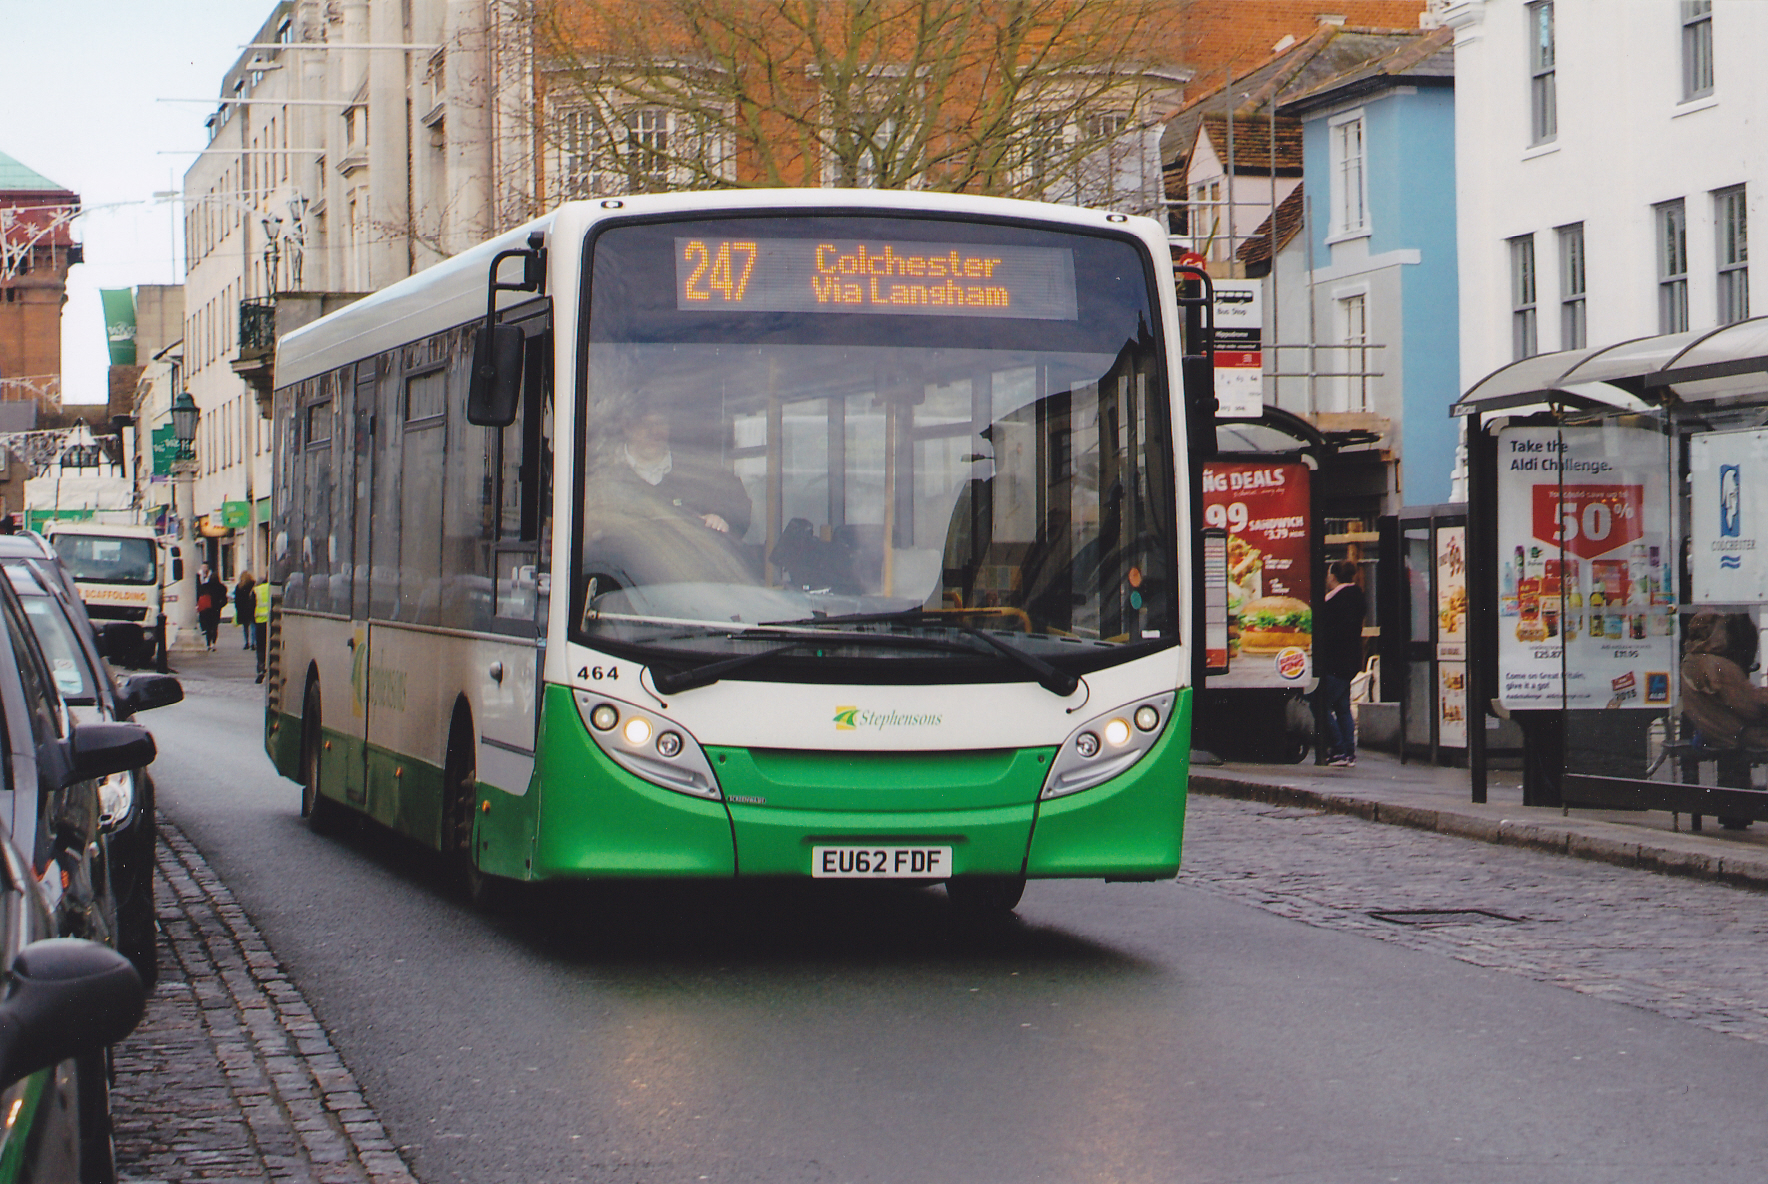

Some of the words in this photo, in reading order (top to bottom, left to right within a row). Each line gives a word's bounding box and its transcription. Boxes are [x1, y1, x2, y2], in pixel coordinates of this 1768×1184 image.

[815, 244, 1002, 278] Colchester
[684, 241, 757, 302] 247
[812, 276, 862, 304] Via
[870, 277, 1009, 307] Langham
[1510, 440, 1543, 453] Take
[1546, 440, 1568, 453] the
[1510, 457, 1538, 471] Aldi
[1229, 467, 1286, 490] DEALS
[1249, 516, 1304, 531] SANDWICH
[1711, 539, 1757, 551] COLCHESTER
[85, 589, 147, 601] SCAFFOLDING
[577, 666, 619, 681] 464
[1280, 659, 1305, 674] KING
[1649, 692, 1666, 700] ALDI
[860, 709, 943, 731] Stephensons
[822, 851, 888, 873] EU62
[894, 851, 942, 873] FDF
